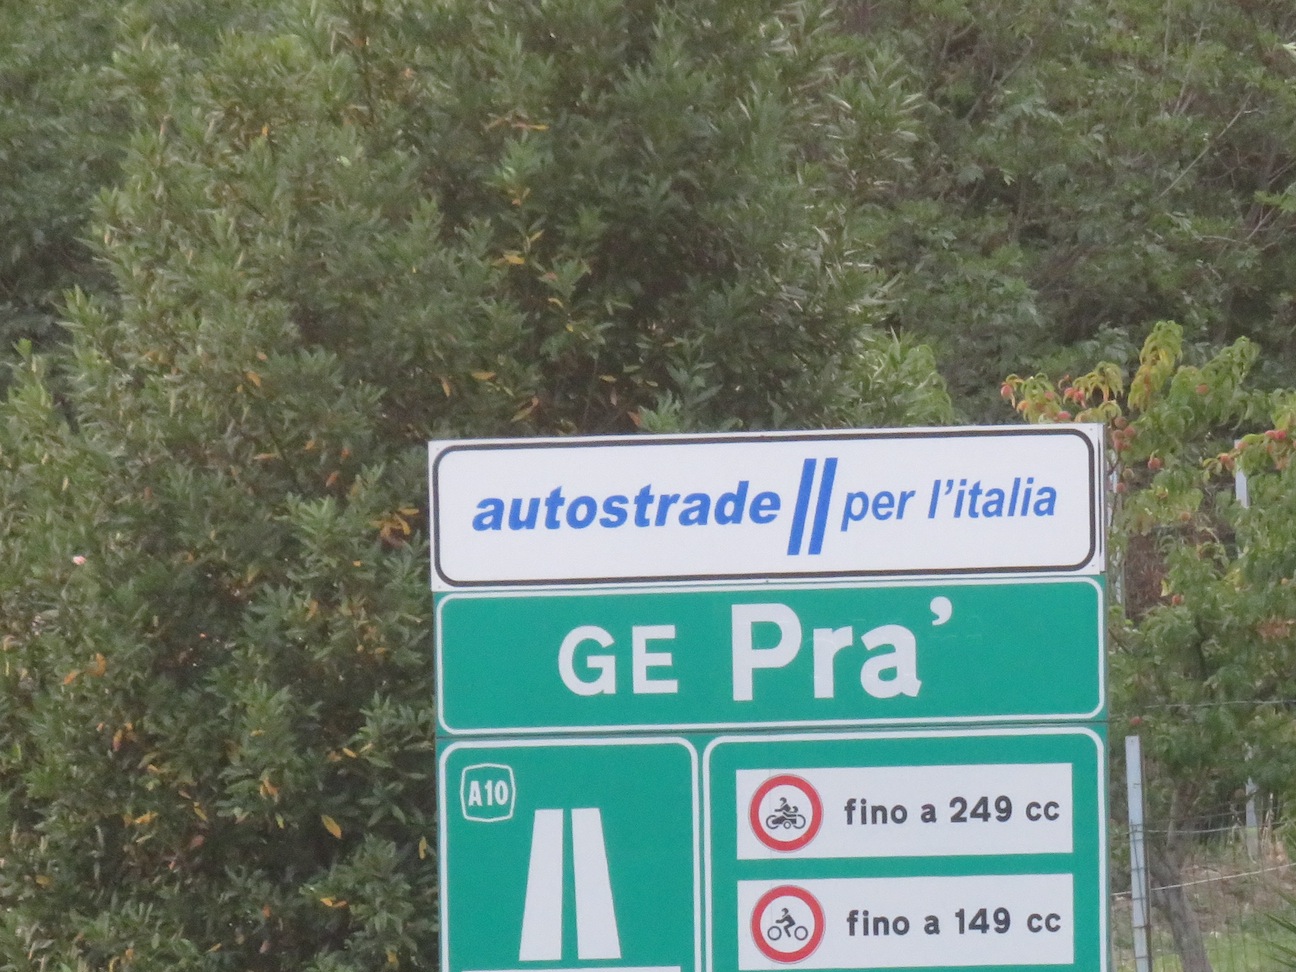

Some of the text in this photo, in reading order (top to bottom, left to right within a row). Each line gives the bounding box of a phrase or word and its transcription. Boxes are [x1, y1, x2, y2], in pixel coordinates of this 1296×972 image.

[472, 480, 782, 532] autostrade
[840, 490, 917, 532] per
[557, 624, 679, 696] GE
[468, 779, 509, 807] A10
[844, 795, 1060, 825] fino a 249 cc
[846, 907, 1061, 937] fino a 149 cc
